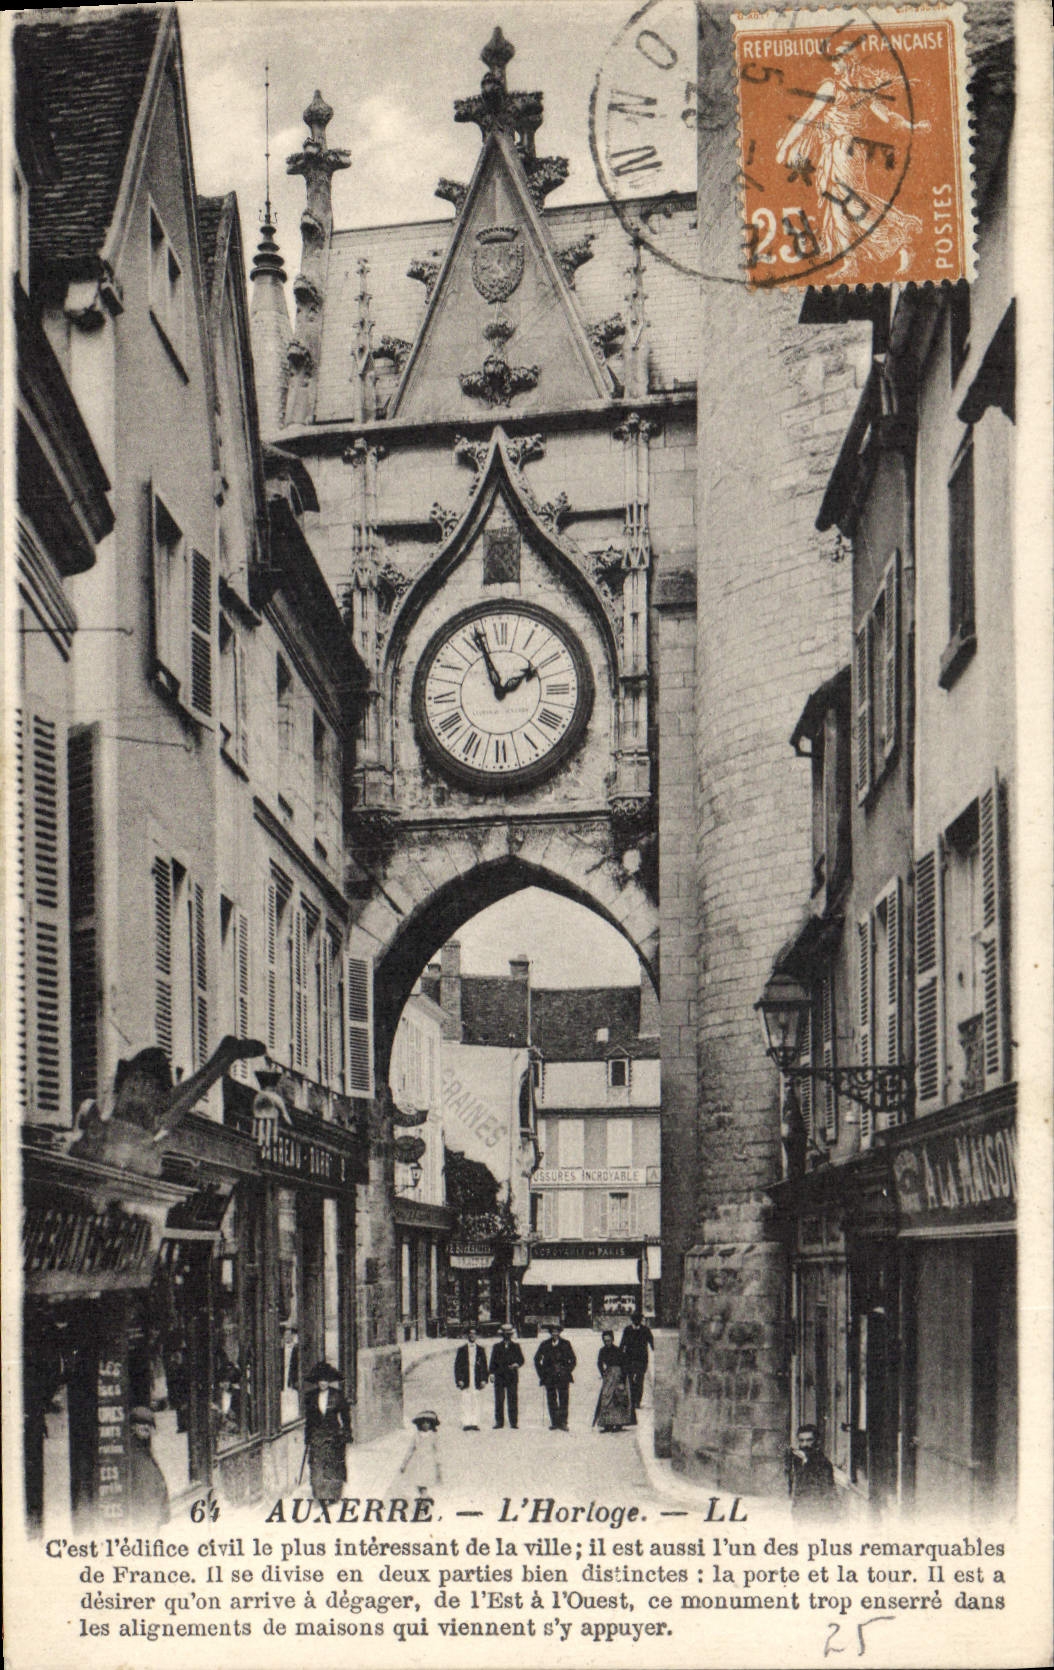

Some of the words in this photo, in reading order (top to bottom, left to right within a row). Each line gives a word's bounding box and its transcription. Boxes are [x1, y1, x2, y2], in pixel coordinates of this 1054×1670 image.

[932, 183, 954, 269] POSTES
[441, 1068, 508, 1148] GRAINES
[581, 1168, 639, 1182] INCROYABLE
[823, 1615, 896, 1658] 25
